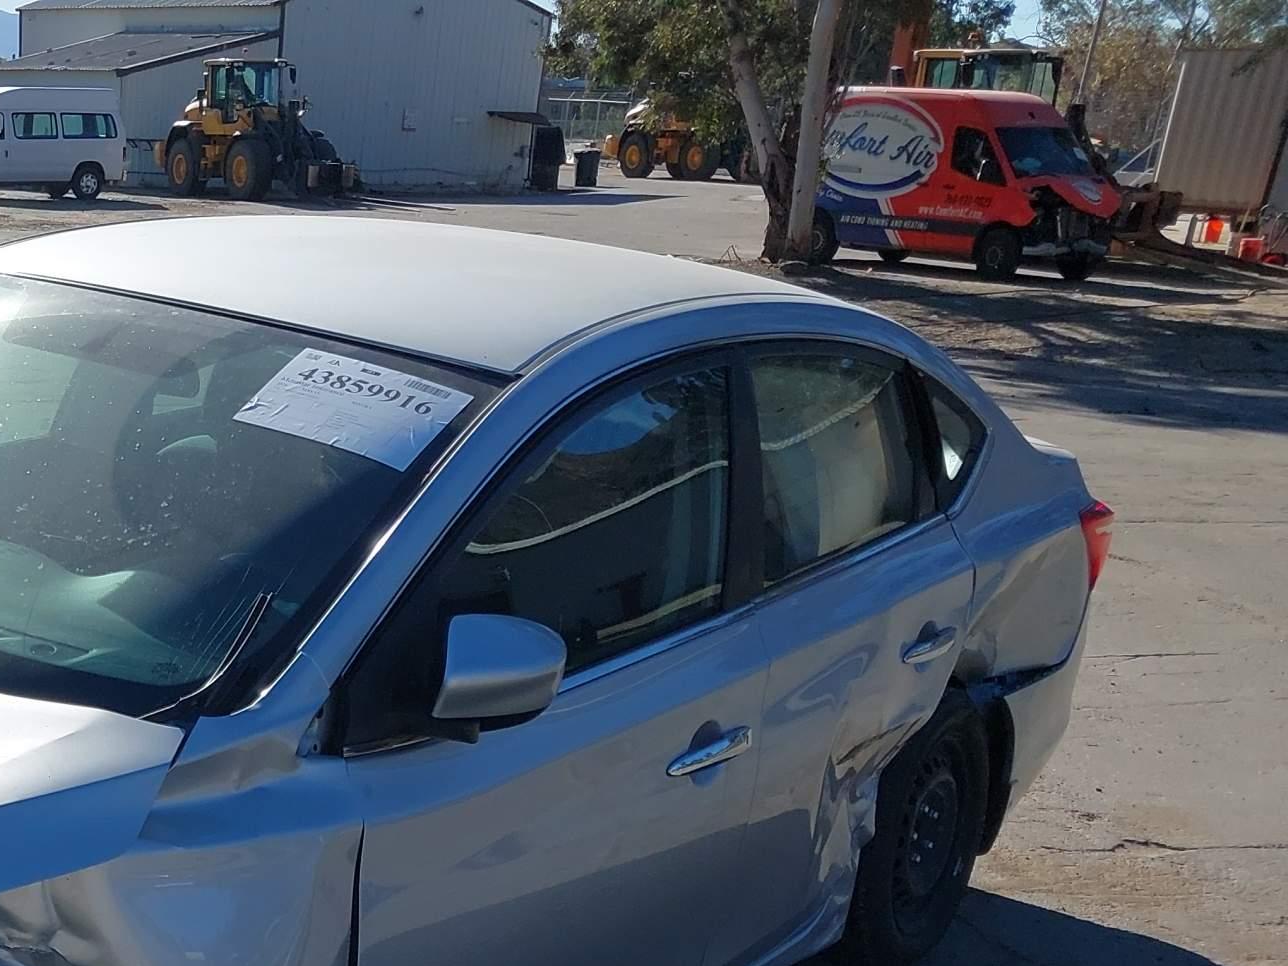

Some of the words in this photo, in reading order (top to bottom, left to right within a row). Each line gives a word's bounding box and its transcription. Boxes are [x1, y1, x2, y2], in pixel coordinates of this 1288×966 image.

[890, 135, 934, 168] Air
[840, 215, 850, 223] AIR
[890, 219, 903, 228] AND
[298, 367, 438, 415] 43859916
